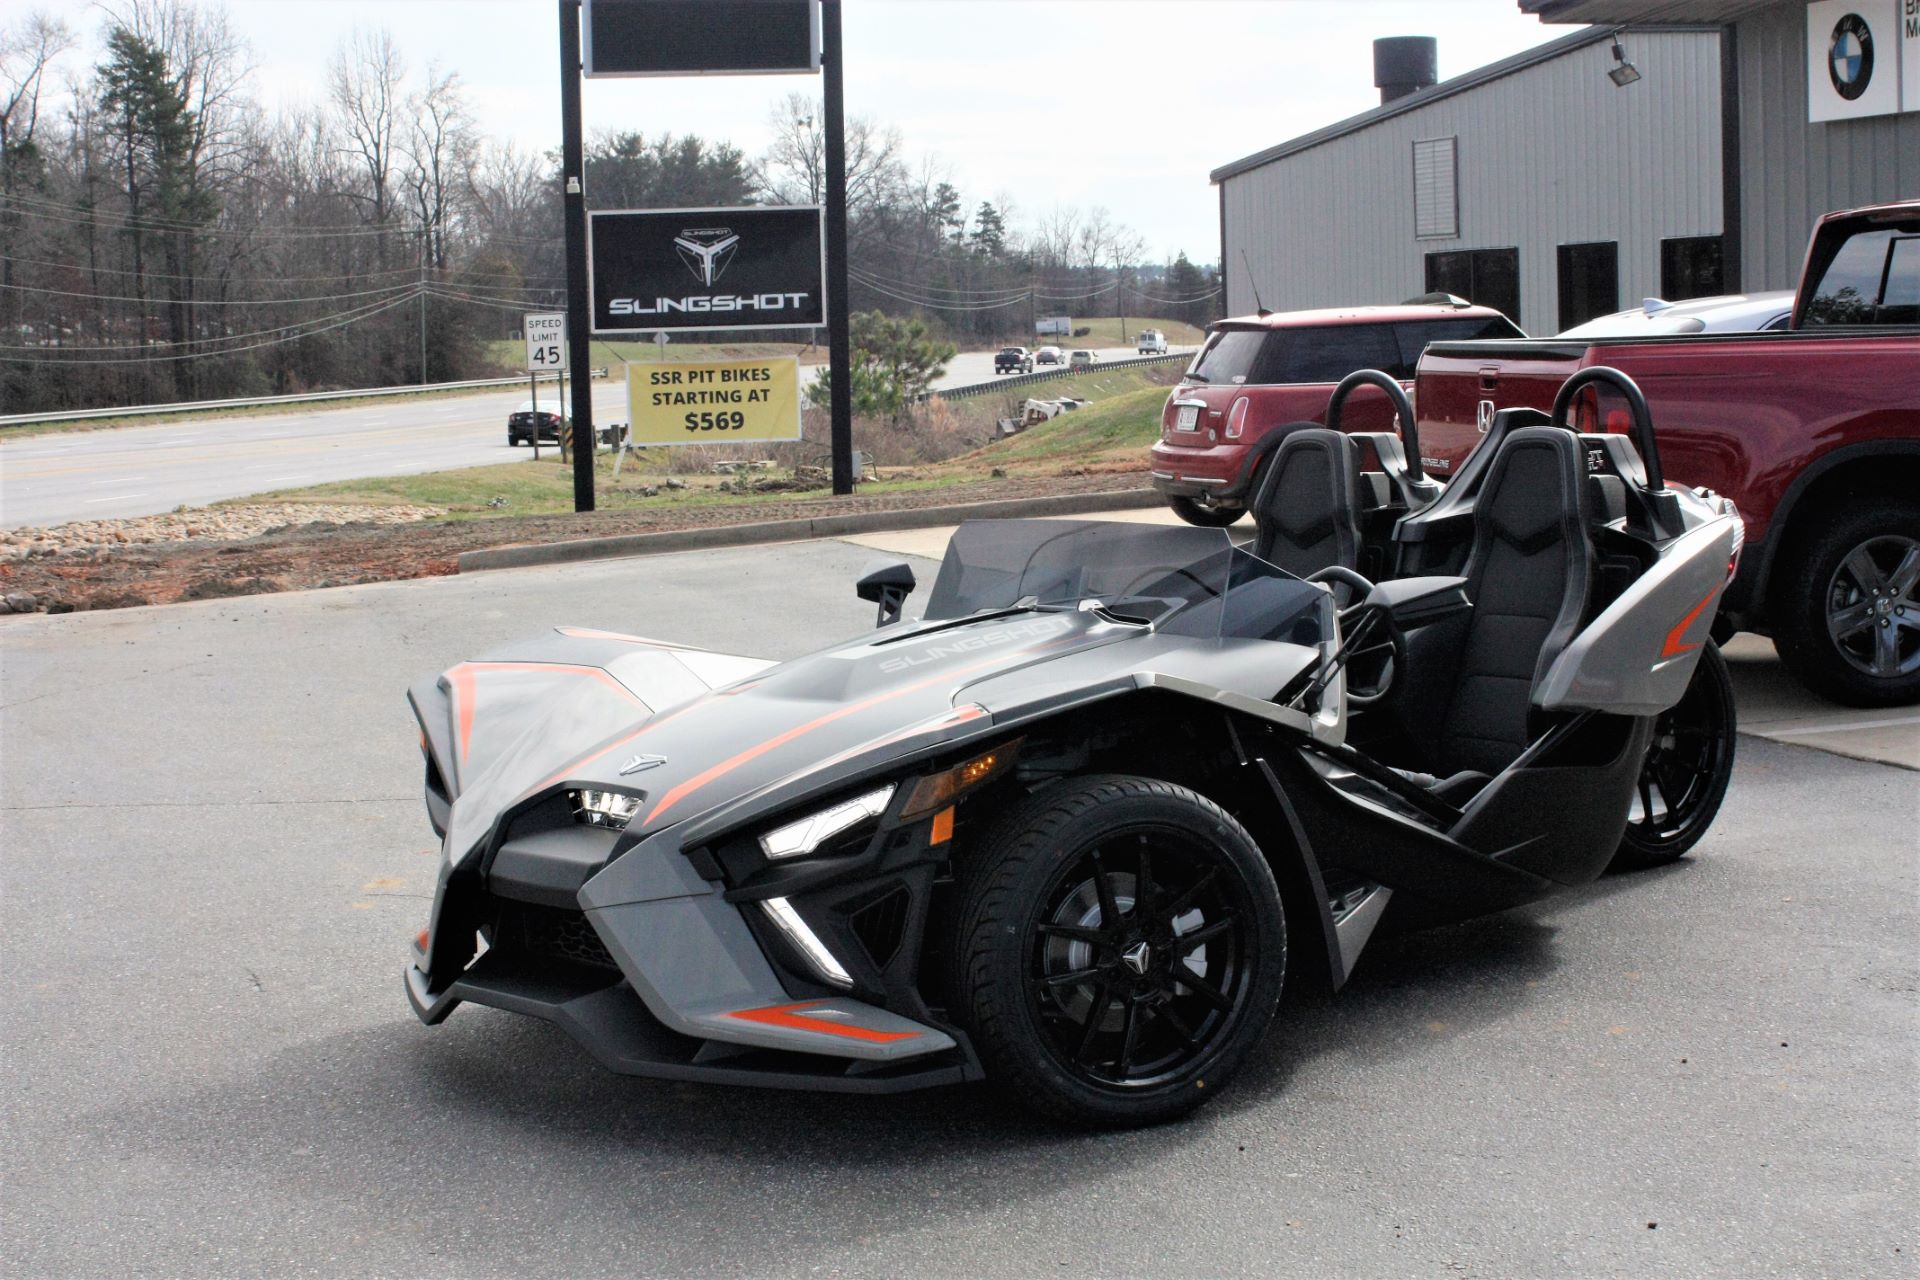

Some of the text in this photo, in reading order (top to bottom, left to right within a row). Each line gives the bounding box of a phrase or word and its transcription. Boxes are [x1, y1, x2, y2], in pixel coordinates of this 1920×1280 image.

[609, 293, 809, 314] SLINGSHOT
[528, 319, 562, 329] SPEED
[532, 332, 558, 342] LIMIT
[533, 346, 560, 365] 45
[650, 368, 771, 385] SSR PIT BIKES
[652, 388, 770, 406] STARTING AT
[685, 411, 745, 433] $569
[879, 616, 1074, 673] SLINGSHOT
